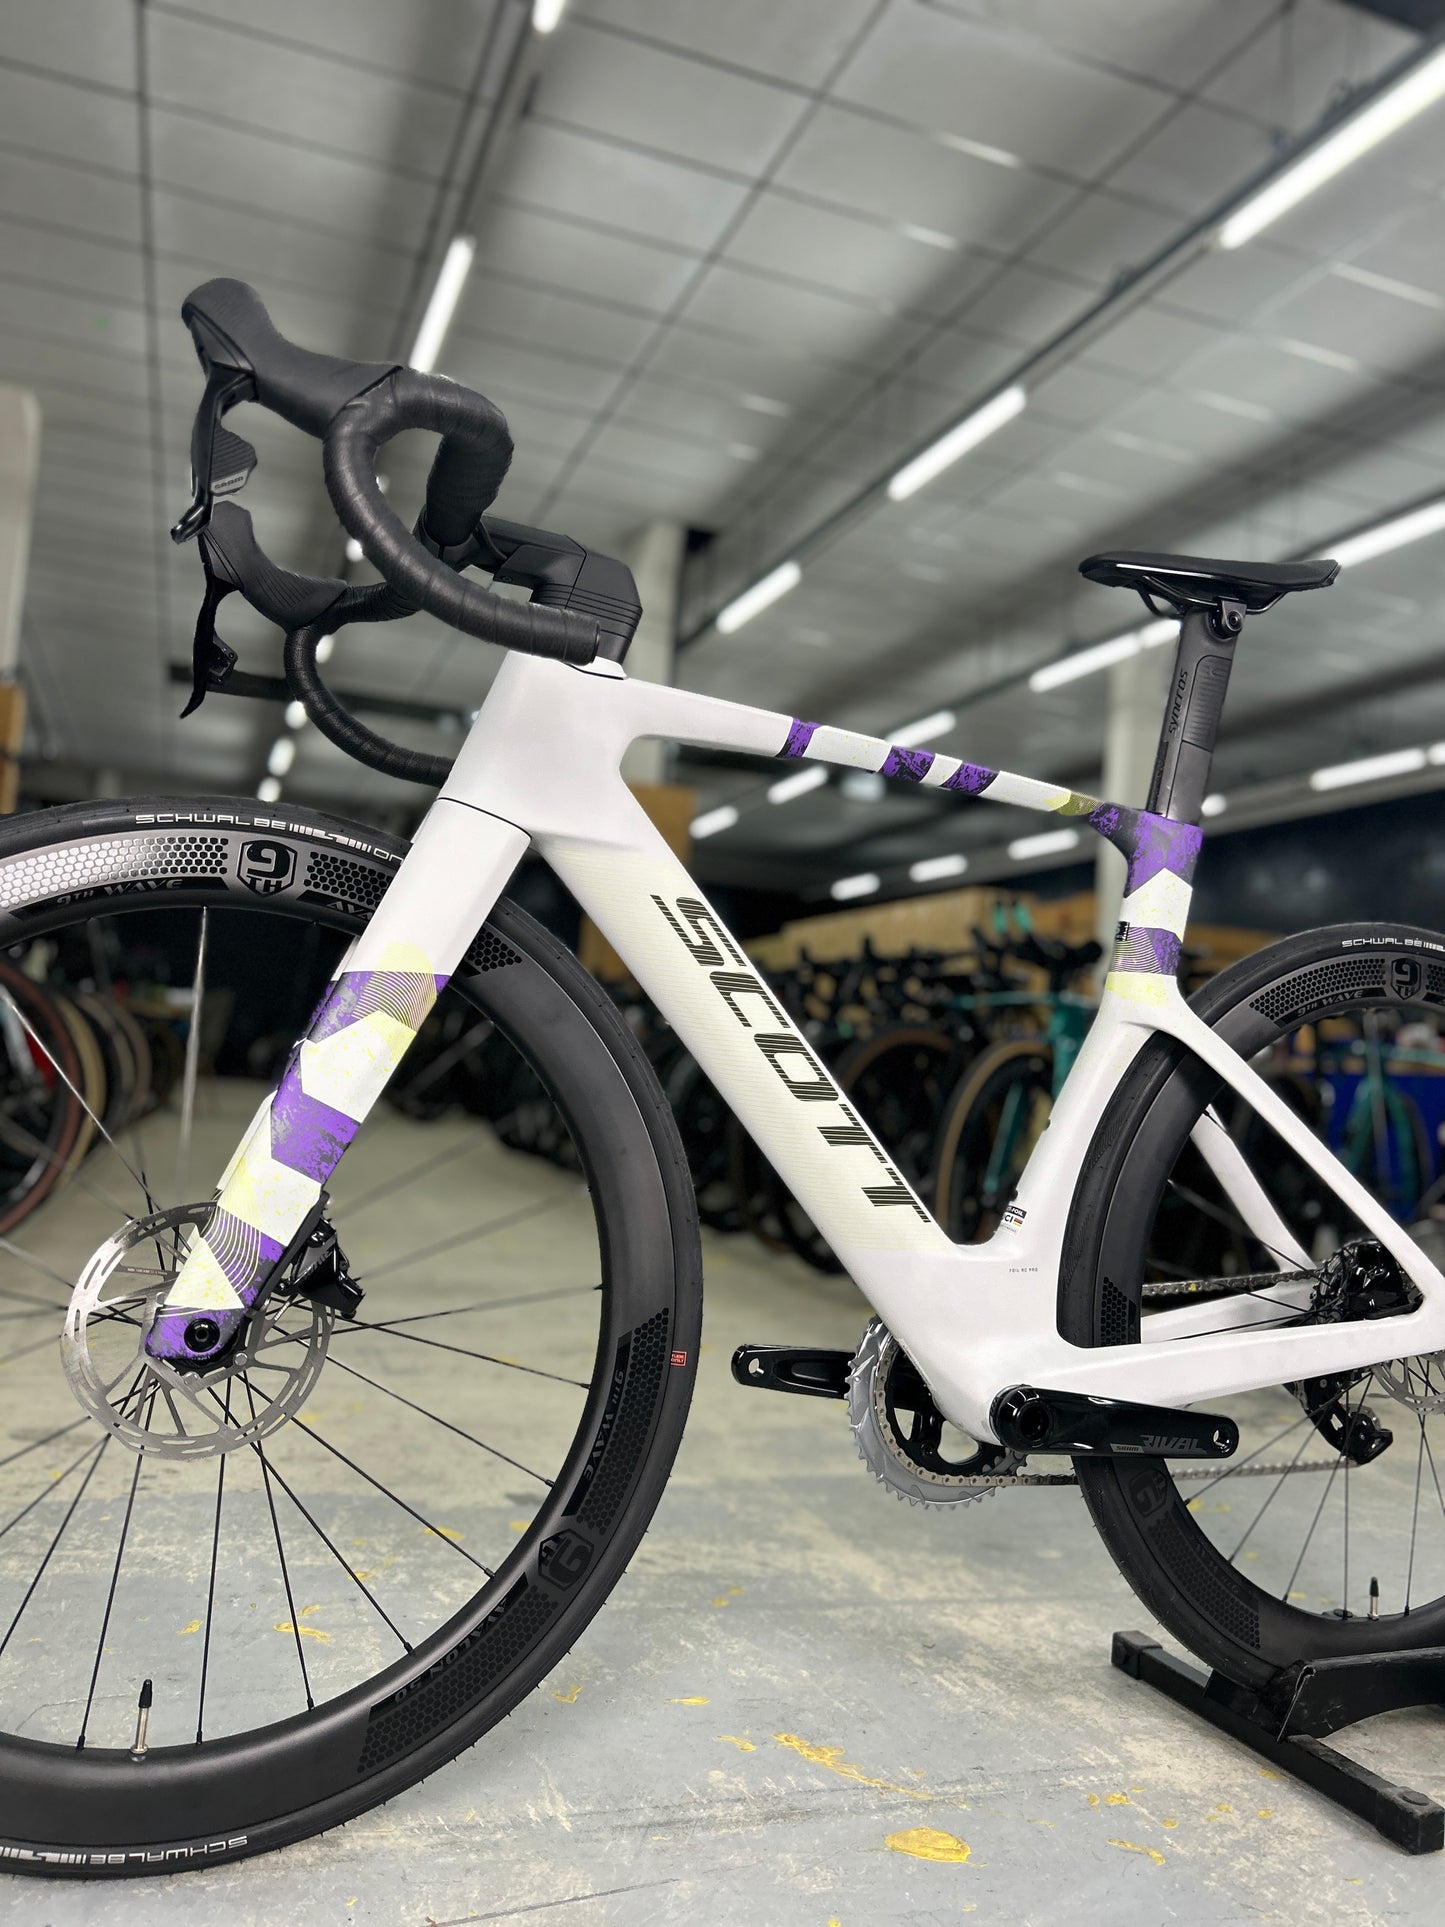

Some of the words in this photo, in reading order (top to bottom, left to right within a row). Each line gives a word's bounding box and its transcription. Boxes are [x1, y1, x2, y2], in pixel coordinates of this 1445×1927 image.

[135, 813, 286, 831] SCHWALBE
[103, 878, 183, 896] WAVE
[1341, 937, 1422, 948] SCHWALBE
[650, 894, 931, 1223] SCOTT
[1140, 1434, 1206, 1453] RIVAL
[89, 1835, 248, 1865] SCHWALBE
